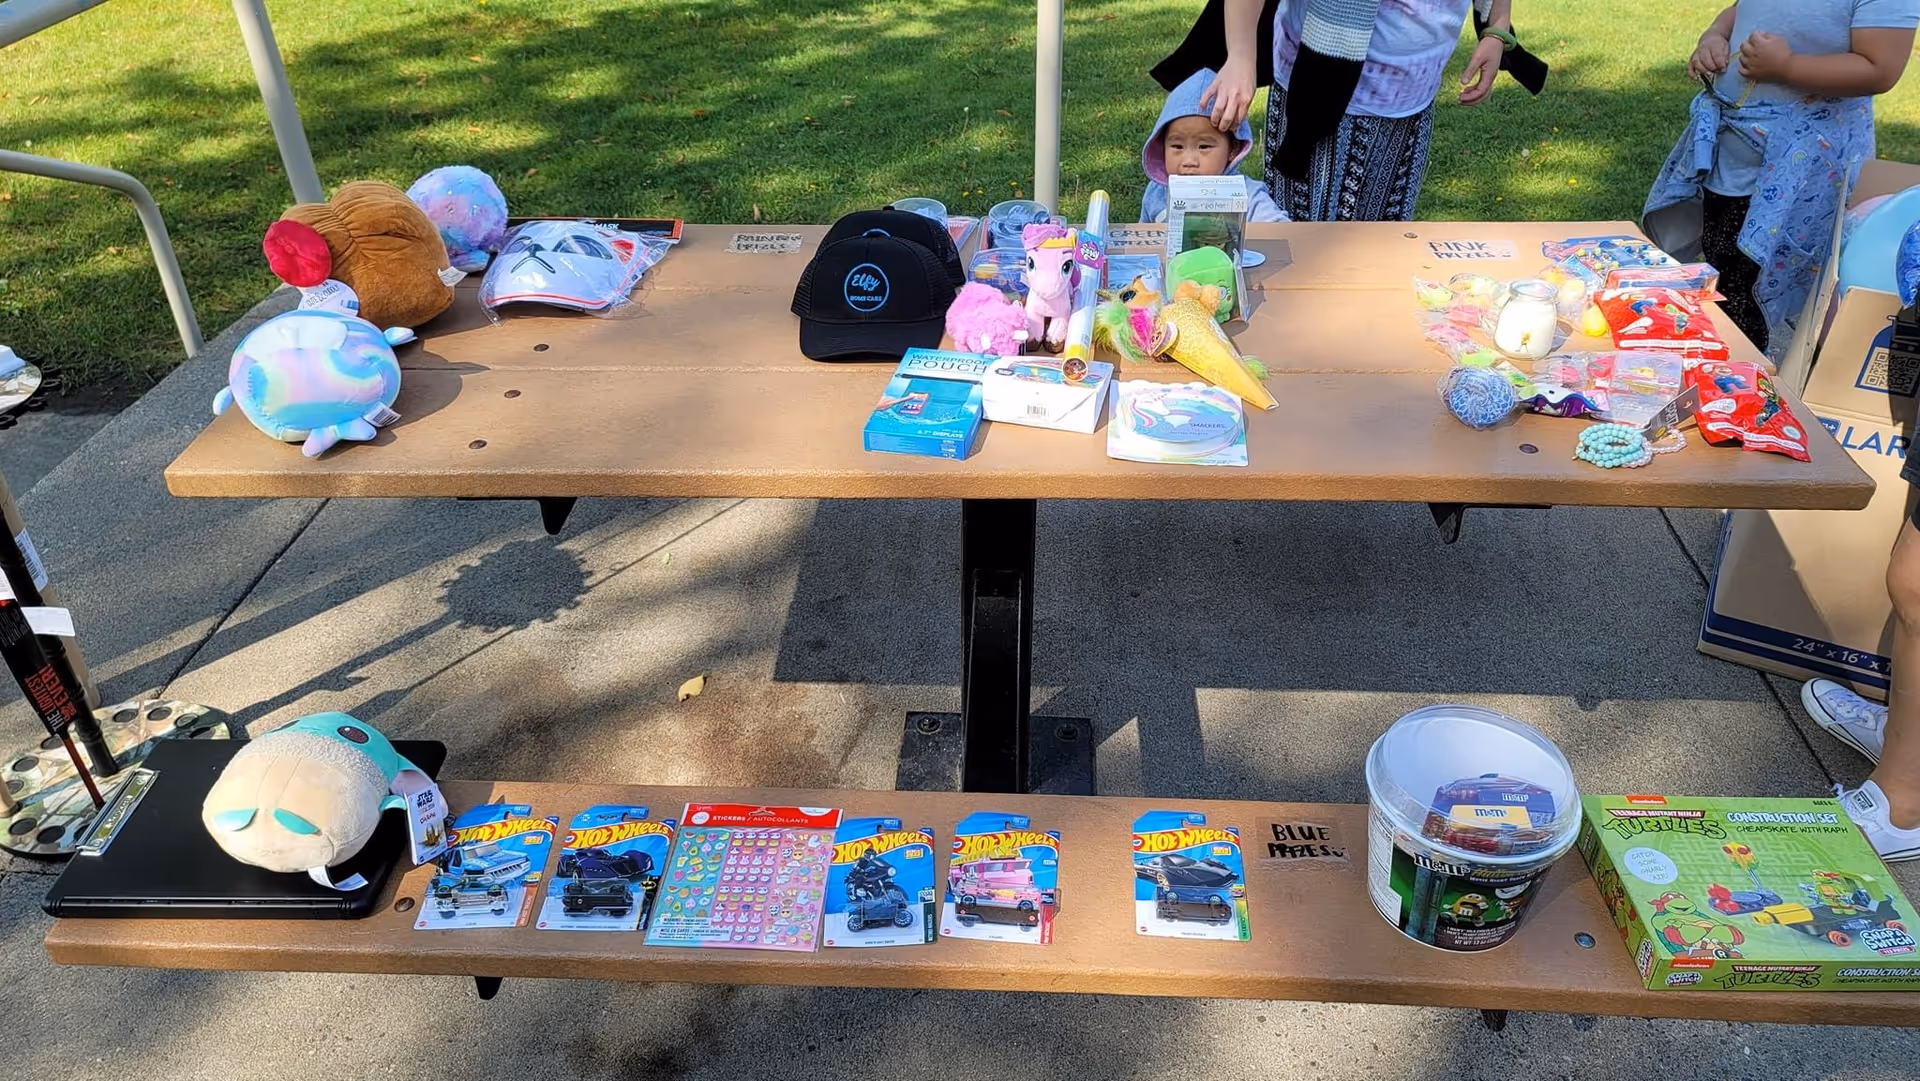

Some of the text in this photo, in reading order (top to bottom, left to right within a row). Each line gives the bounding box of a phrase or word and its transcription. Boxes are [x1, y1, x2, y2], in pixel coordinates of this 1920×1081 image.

[1428, 242, 1487, 251] PINK
[851, 273, 880, 291] Elfy
[908, 358, 988, 374] POUCH
[1792, 638, 1824, 653] 24"
[1842, 651, 1868, 664] 16"
[25, 673, 65, 732] THE LIGHTEST
[417, 790, 433, 802] STAR
[417, 795, 434, 808] WARS
[752, 816, 809, 824] AUTOCOLLANTS
[1726, 812, 1839, 824] CONSTRUCTION SET
[1271, 823, 1330, 842] BLUE
[1602, 817, 1727, 840] TURTLES
[1822, 826, 1848, 834] RAPH
[1862, 930, 1894, 940] SNAP
[1865, 936, 1914, 950] SWITCH
[1718, 950, 1727, 958] R
[1836, 967, 1912, 976] CONSTRUCTION
[1713, 971, 1822, 989] TURTLES
